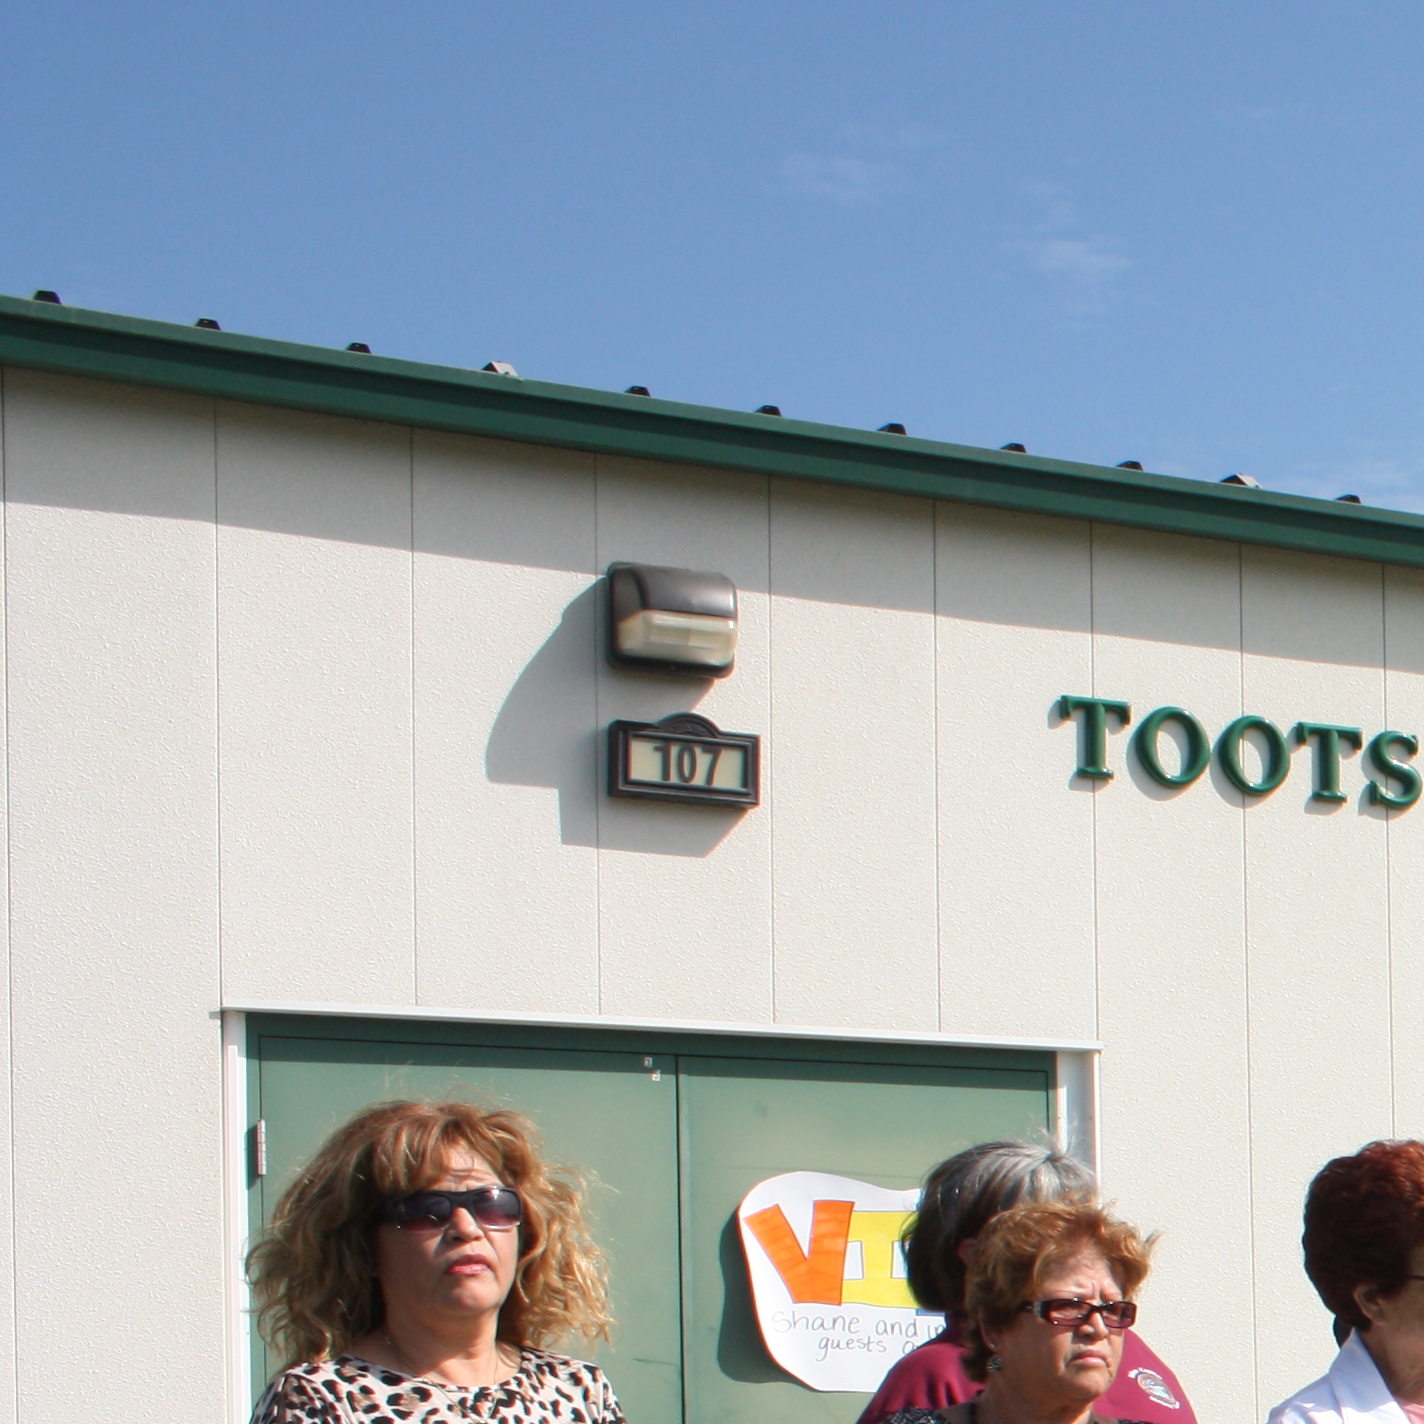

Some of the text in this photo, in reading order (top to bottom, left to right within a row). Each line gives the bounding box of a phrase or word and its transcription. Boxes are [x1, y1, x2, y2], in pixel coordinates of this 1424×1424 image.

[653, 740, 723, 786] 107
[1059, 694, 1422, 810] TOOTS
[771, 1310, 861, 1335] Shane
[875, 1318, 918, 1339] and
[815, 1335, 887, 1362] guests
